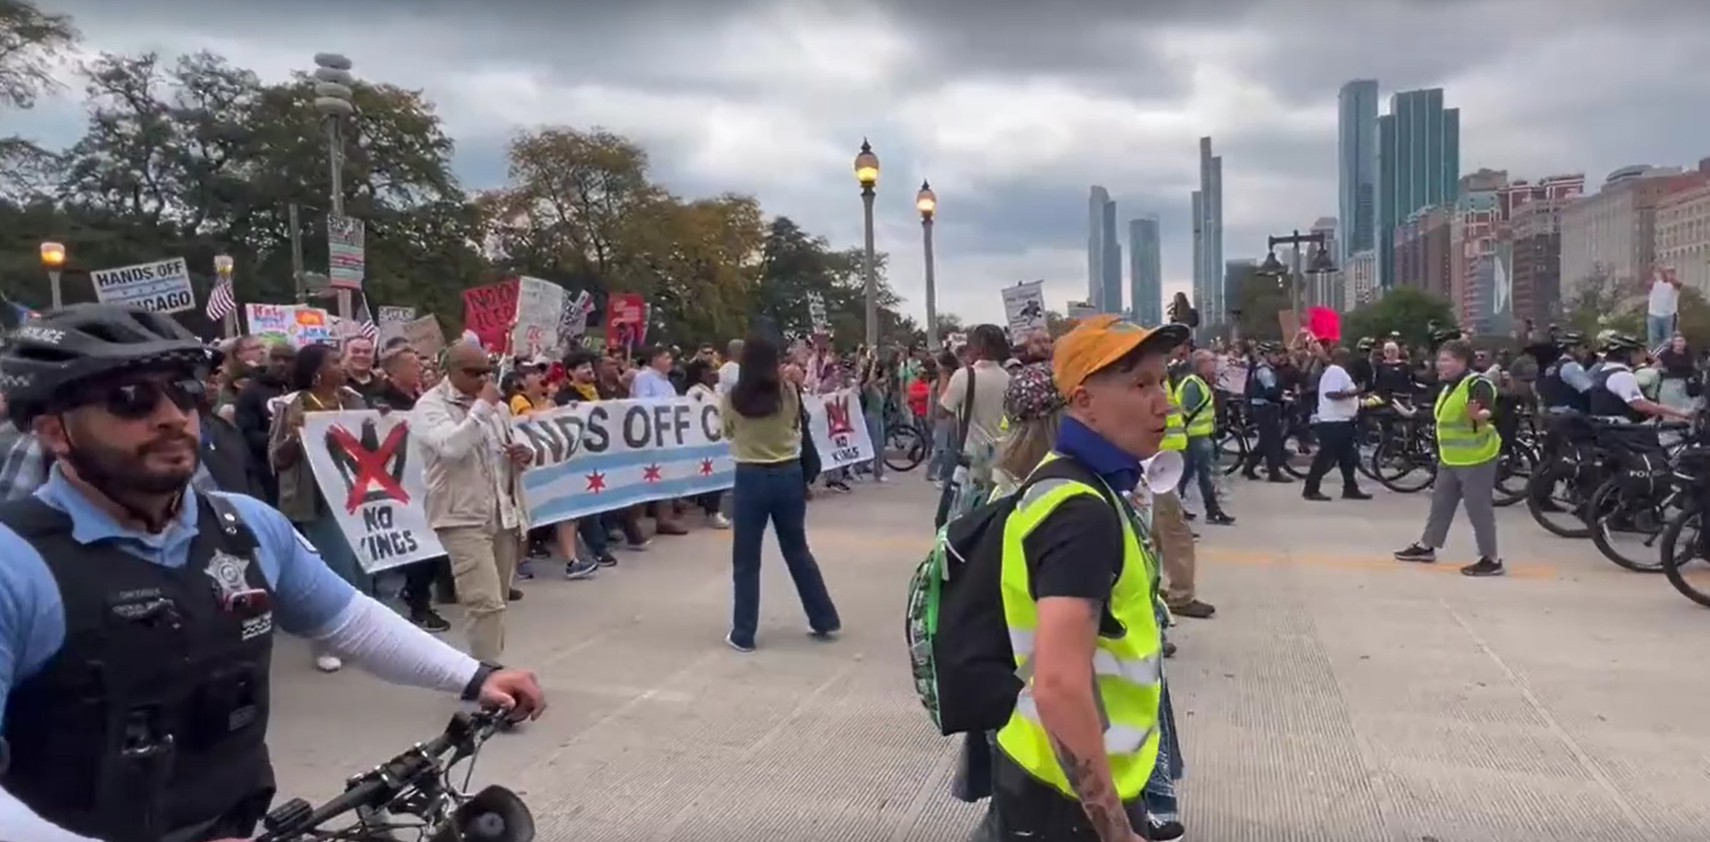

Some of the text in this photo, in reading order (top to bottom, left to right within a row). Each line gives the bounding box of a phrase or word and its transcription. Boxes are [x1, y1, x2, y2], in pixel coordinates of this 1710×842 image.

[97, 260, 183, 288] HANDS OFF
[128, 291, 191, 312] CAGO
[516, 405, 610, 464] NDS
[623, 405, 691, 449] OFF
[363, 506, 393, 533] NO
[360, 530, 418, 561] INGS
